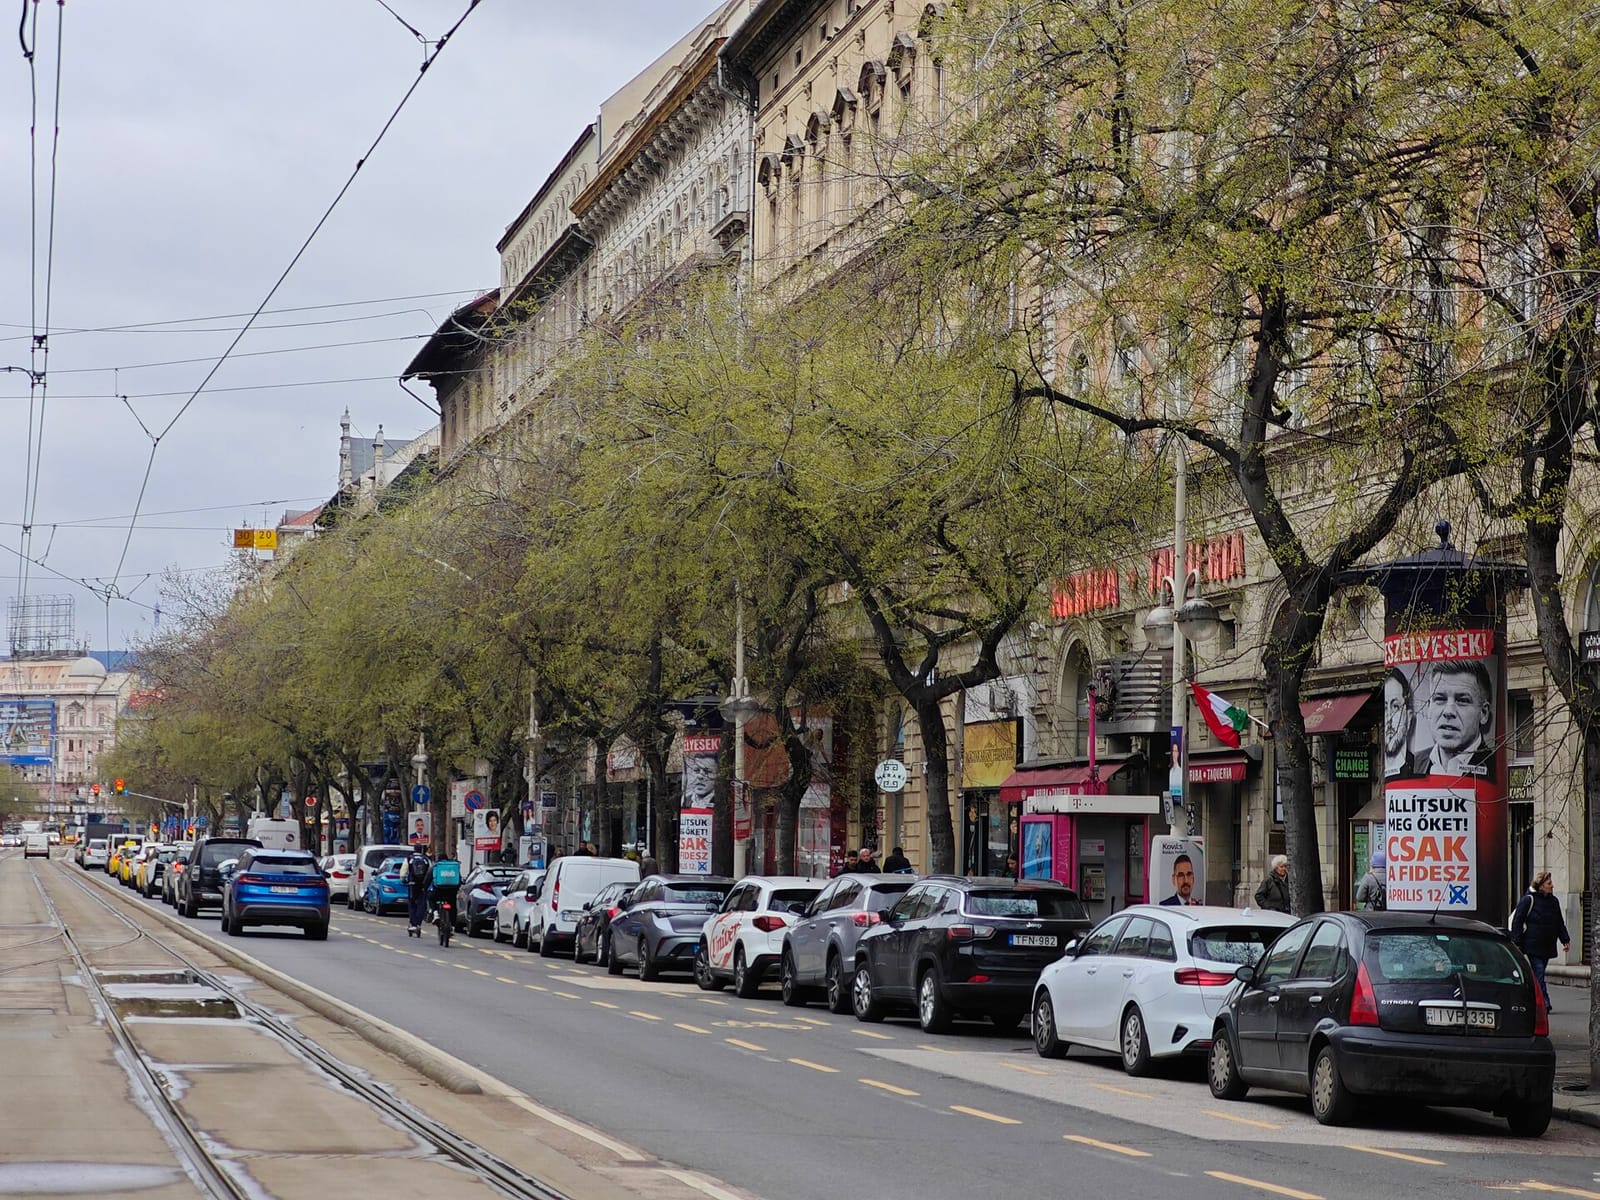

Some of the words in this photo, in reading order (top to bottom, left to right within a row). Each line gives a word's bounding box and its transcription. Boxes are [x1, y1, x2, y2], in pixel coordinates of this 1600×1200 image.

[259, 530, 272, 540] 20
[1335, 758, 1369, 771] CHANGE
[1388, 795, 1467, 813] ÁLLÍTSUK
[1388, 818, 1412, 831] MEG
[1417, 814, 1468, 831] ŐKET!
[1388, 836, 1468, 862] CSAK
[1388, 865, 1396, 881] A
[1399, 865, 1470, 881] FIDESZ
[1388, 885, 1423, 902] ÁPRILIS
[1427, 889, 1446, 902] 12.
[1015, 935, 1056, 946] TFN-982
